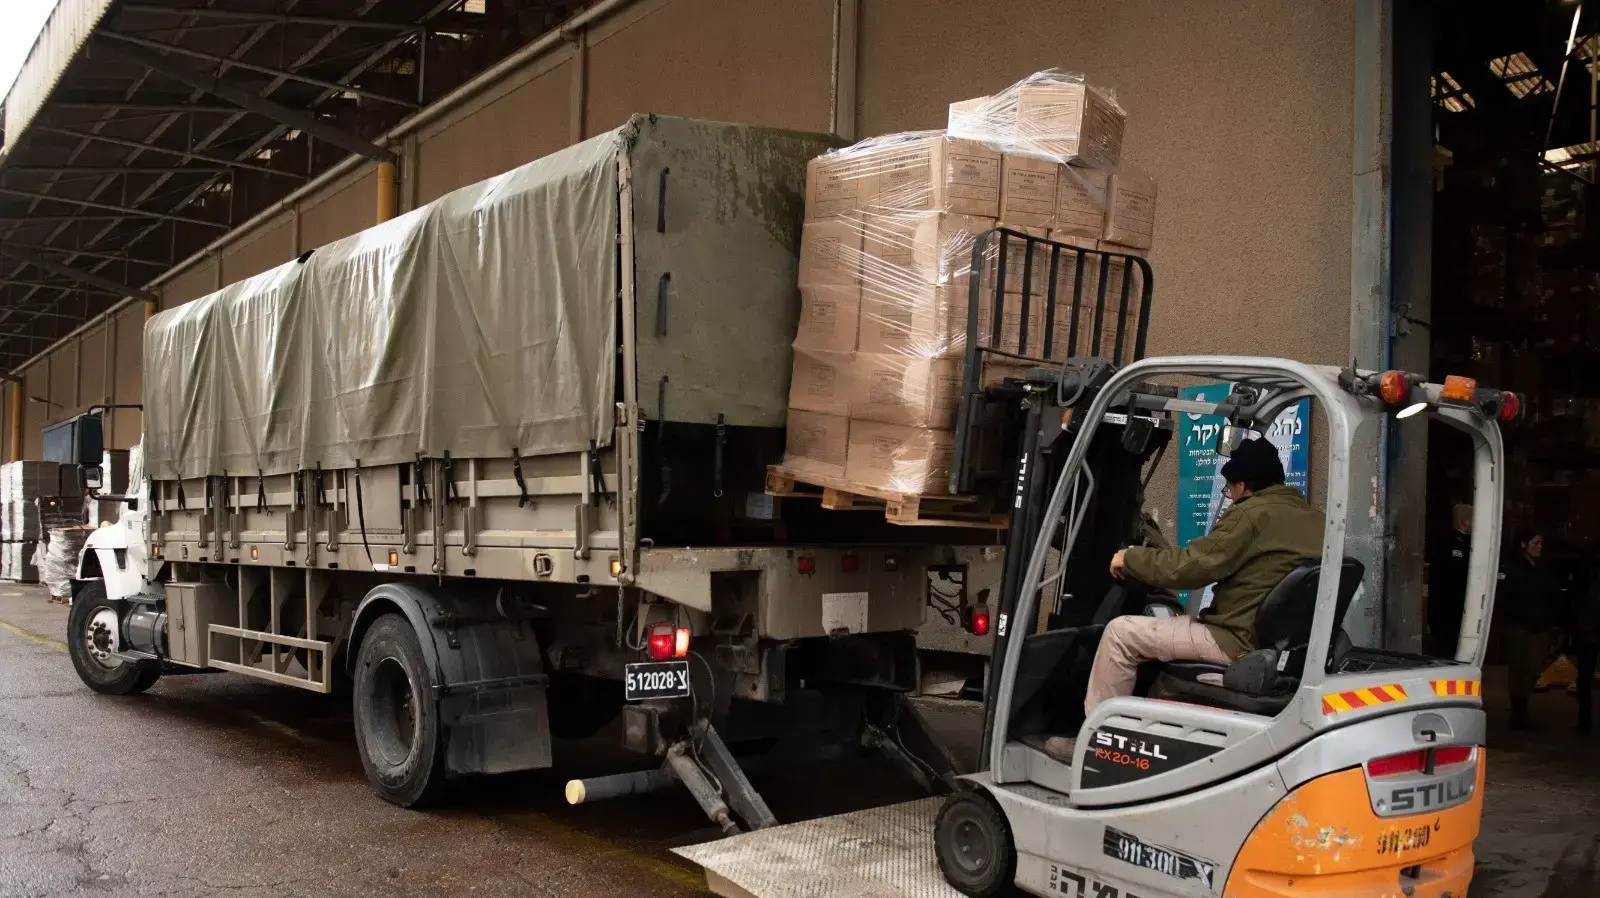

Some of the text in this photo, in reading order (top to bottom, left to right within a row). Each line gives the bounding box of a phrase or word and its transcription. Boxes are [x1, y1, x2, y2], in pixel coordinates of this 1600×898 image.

[1185, 422, 1220, 447] יקר,
[1014, 452, 1028, 509] STILL
[1391, 779, 1469, 811] STILL
